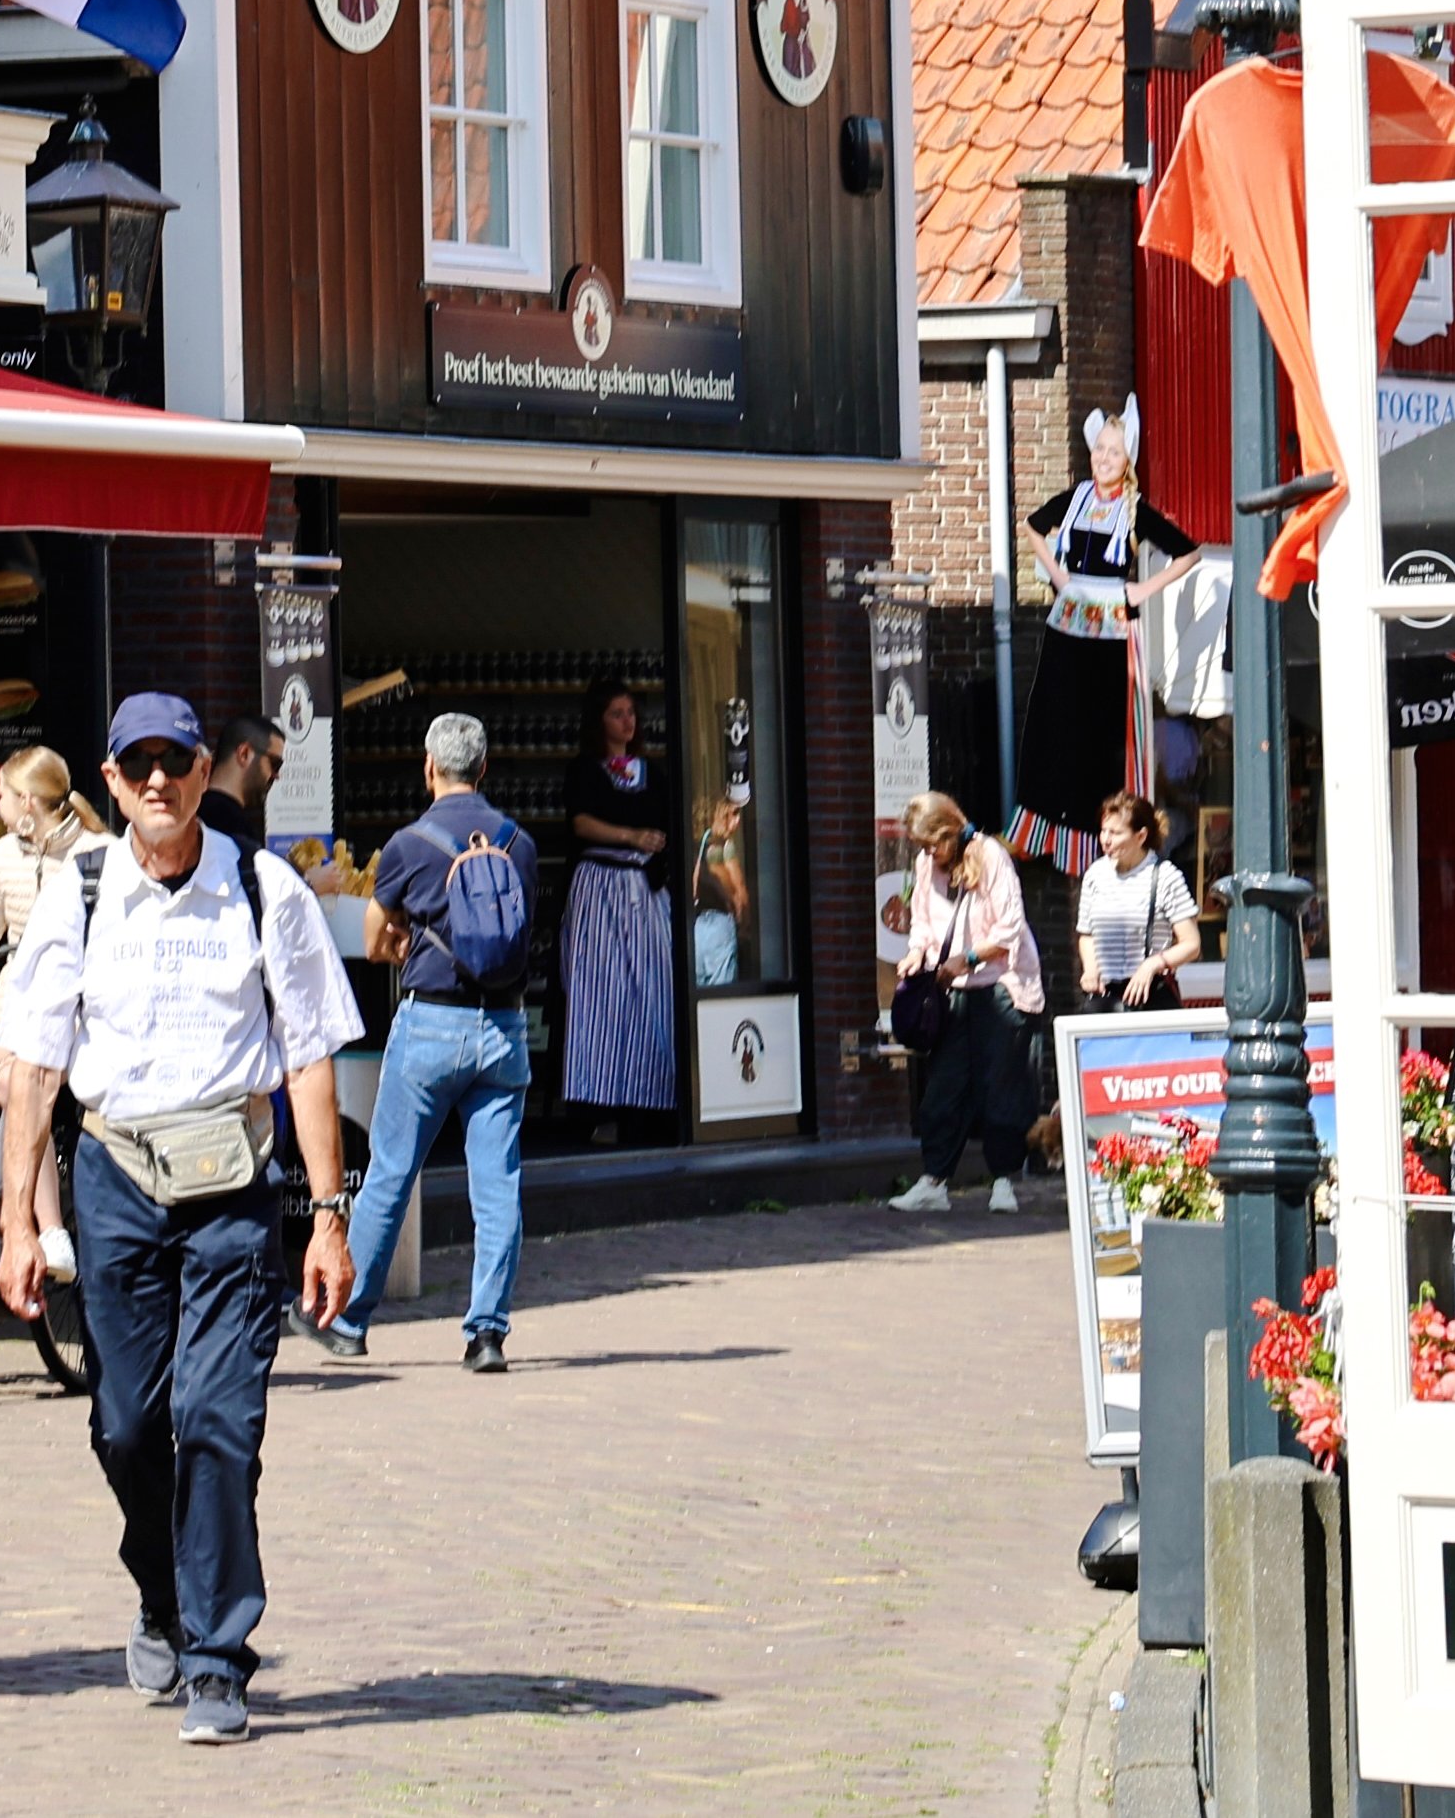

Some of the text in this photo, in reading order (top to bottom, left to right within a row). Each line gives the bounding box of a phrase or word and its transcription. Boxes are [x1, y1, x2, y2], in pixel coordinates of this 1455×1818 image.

[0, 346, 37, 370] only
[444, 351, 735, 402] Proef het best bewaarde geheim van Volendam!
[1408, 562, 1435, 574] made
[112, 938, 228, 962] LEVI STRAUSS
[1103, 1071, 1222, 1102] VISIT OUR
